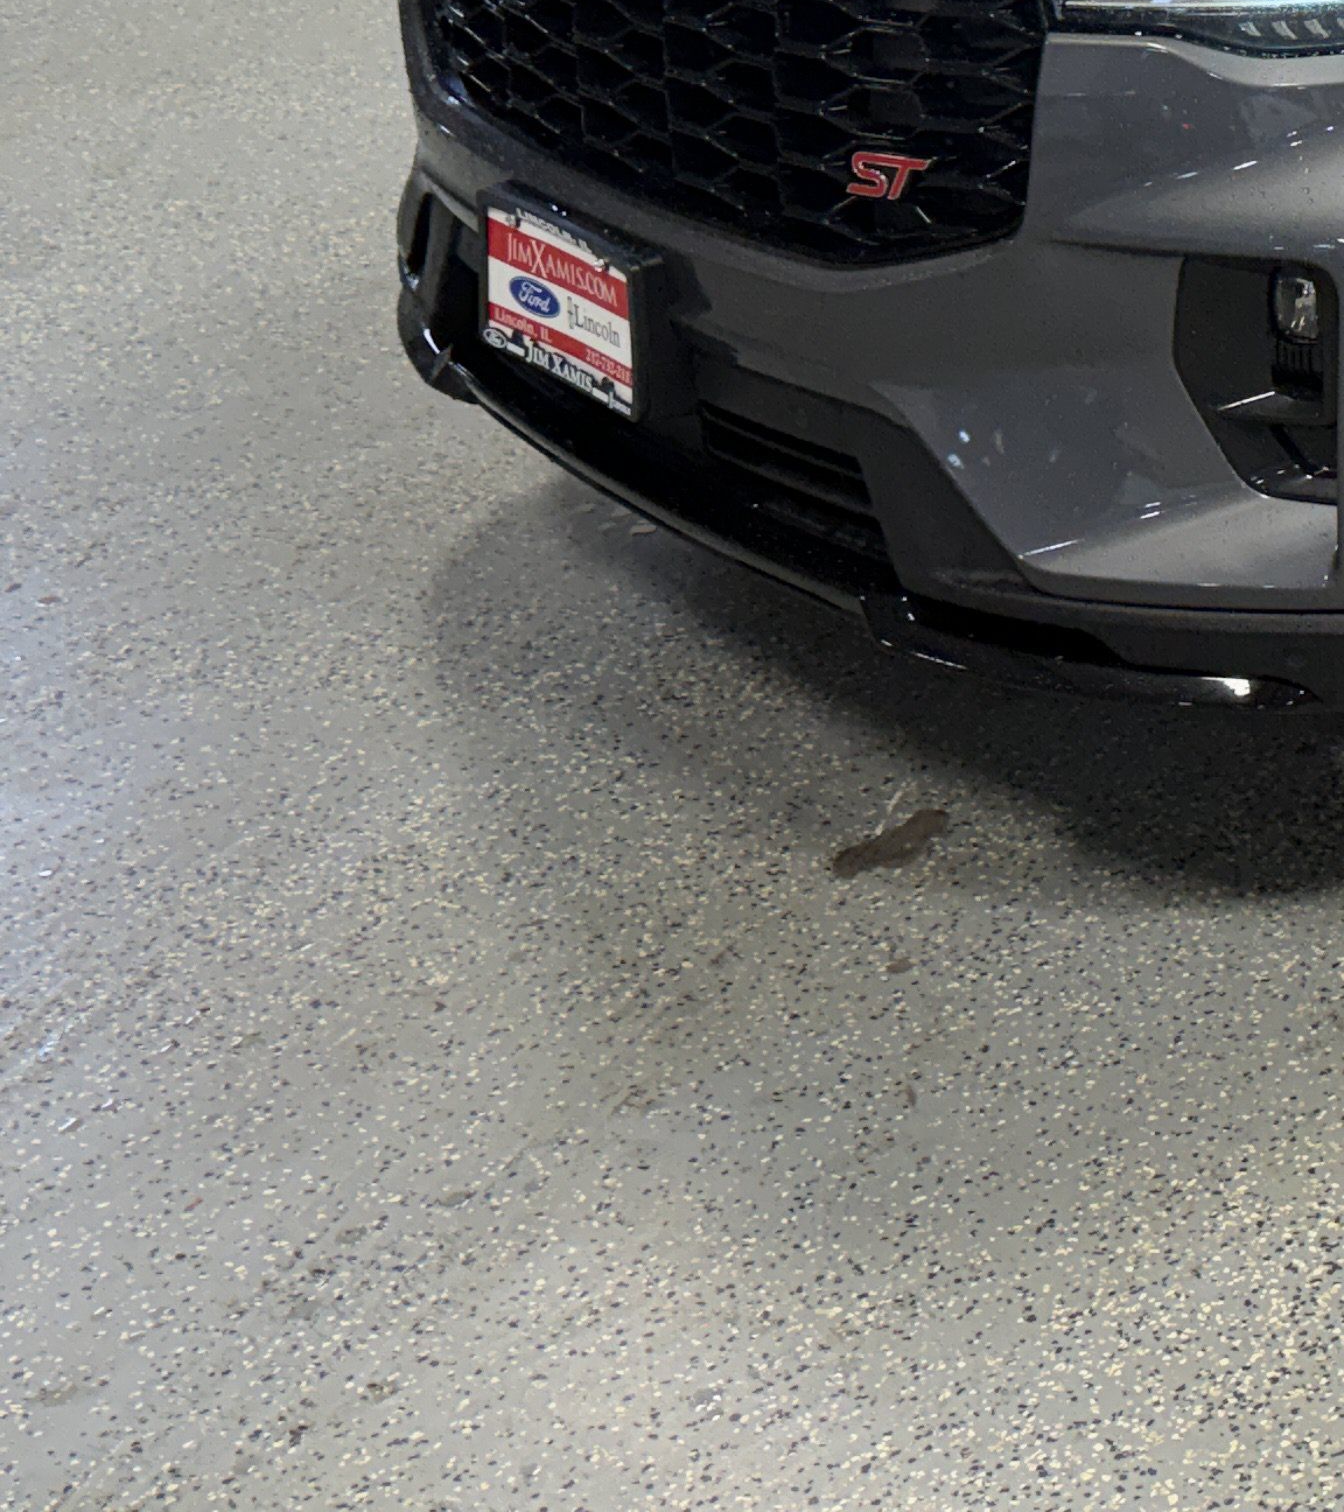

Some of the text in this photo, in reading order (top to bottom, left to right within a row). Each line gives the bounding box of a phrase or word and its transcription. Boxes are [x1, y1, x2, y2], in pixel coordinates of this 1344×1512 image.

[846, 151, 938, 200] ST
[517, 280, 550, 315] Ford
[574, 304, 621, 349] Lincoln
